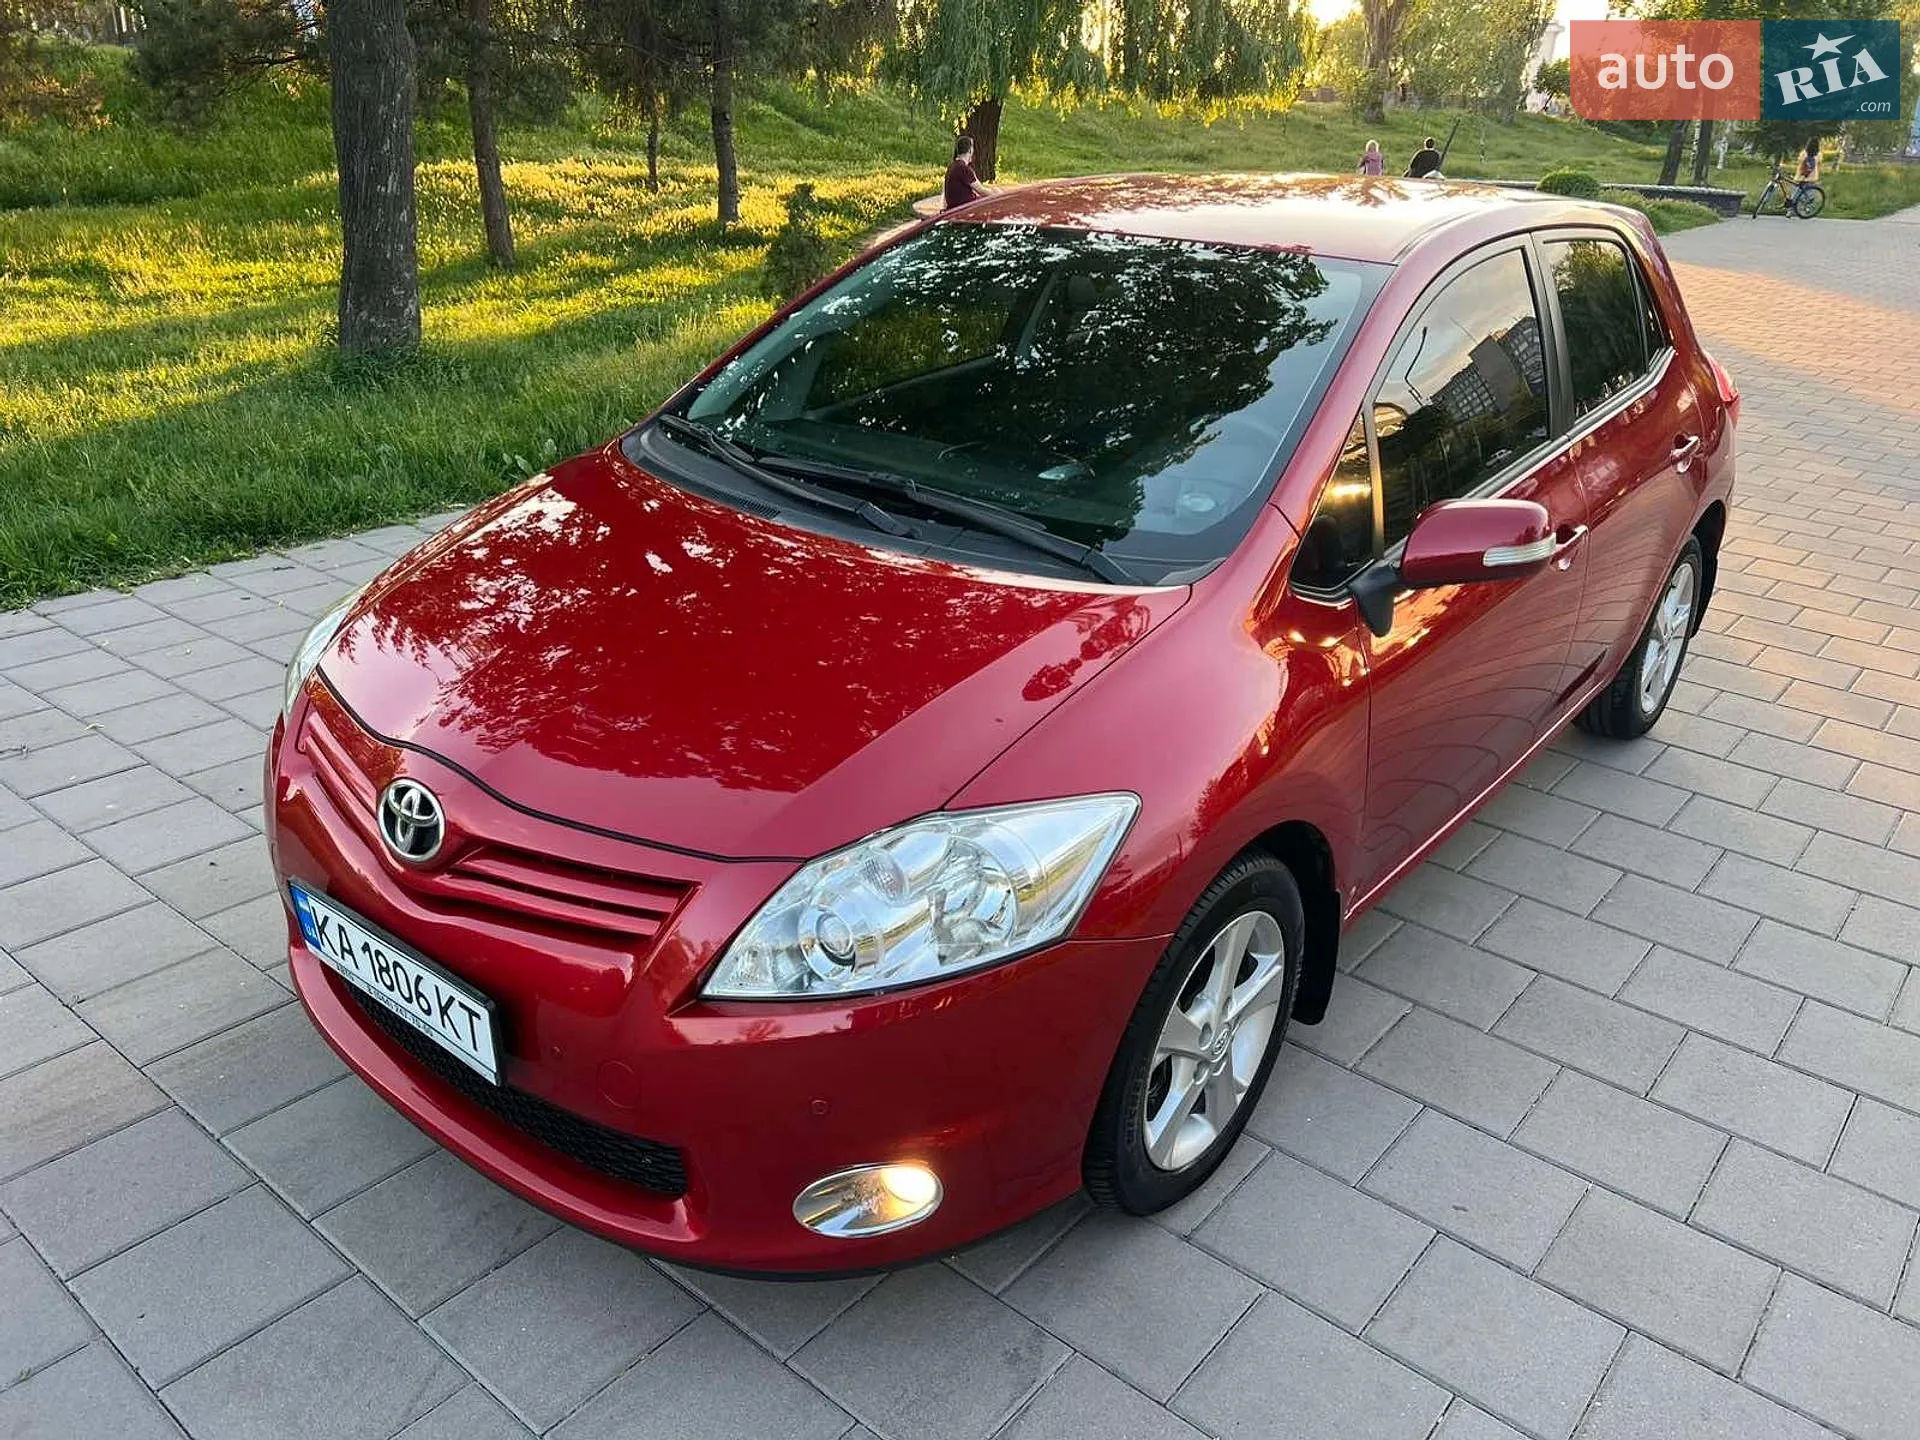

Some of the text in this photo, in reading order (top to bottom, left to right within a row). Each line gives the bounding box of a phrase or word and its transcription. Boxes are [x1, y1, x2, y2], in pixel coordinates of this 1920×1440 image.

[311, 906, 360, 970] KA
[361, 942, 432, 1016] 1806
[435, 984, 482, 1052] KT
